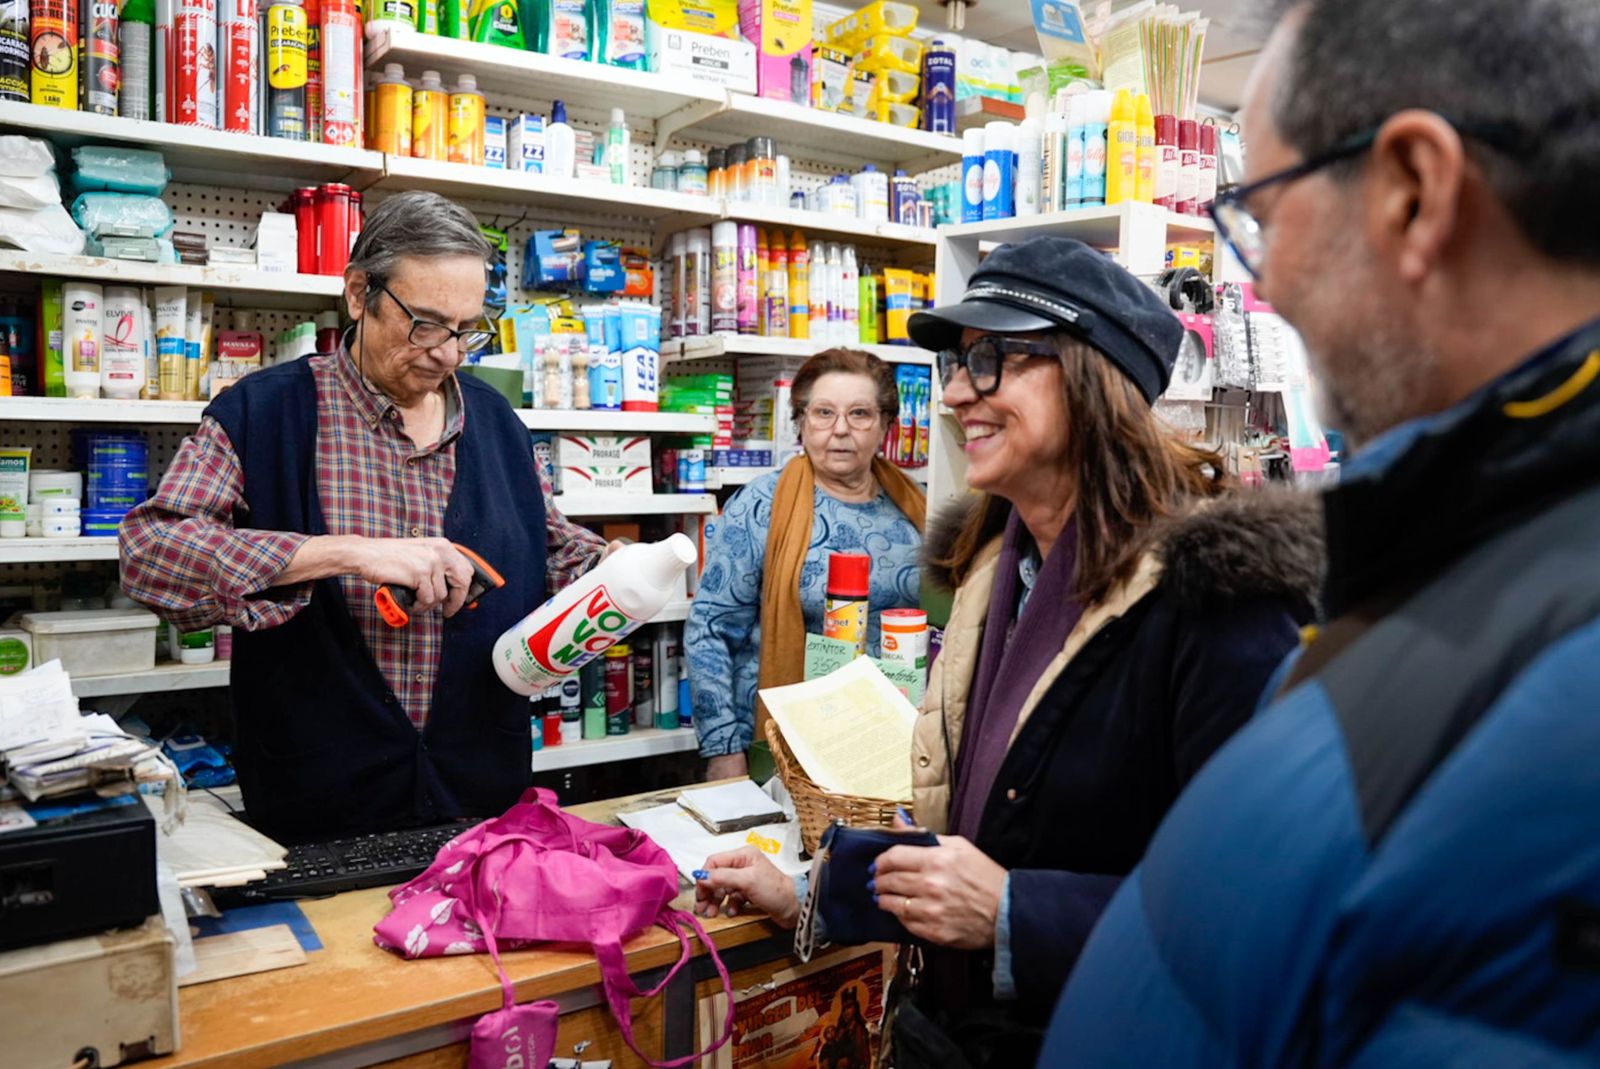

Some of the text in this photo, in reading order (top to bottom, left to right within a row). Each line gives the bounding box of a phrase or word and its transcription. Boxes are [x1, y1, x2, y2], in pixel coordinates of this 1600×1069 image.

[691, 42, 730, 58] Preben
[927, 57, 954, 66] ZOTAL
[486, 146, 503, 161] ZZ
[524, 144, 542, 159] ZZ
[106, 310, 135, 318] ELVIVE
[637, 354, 647, 390] LEA
[592, 449, 620, 459] PRORASO
[595, 478, 622, 488] PRORASO
